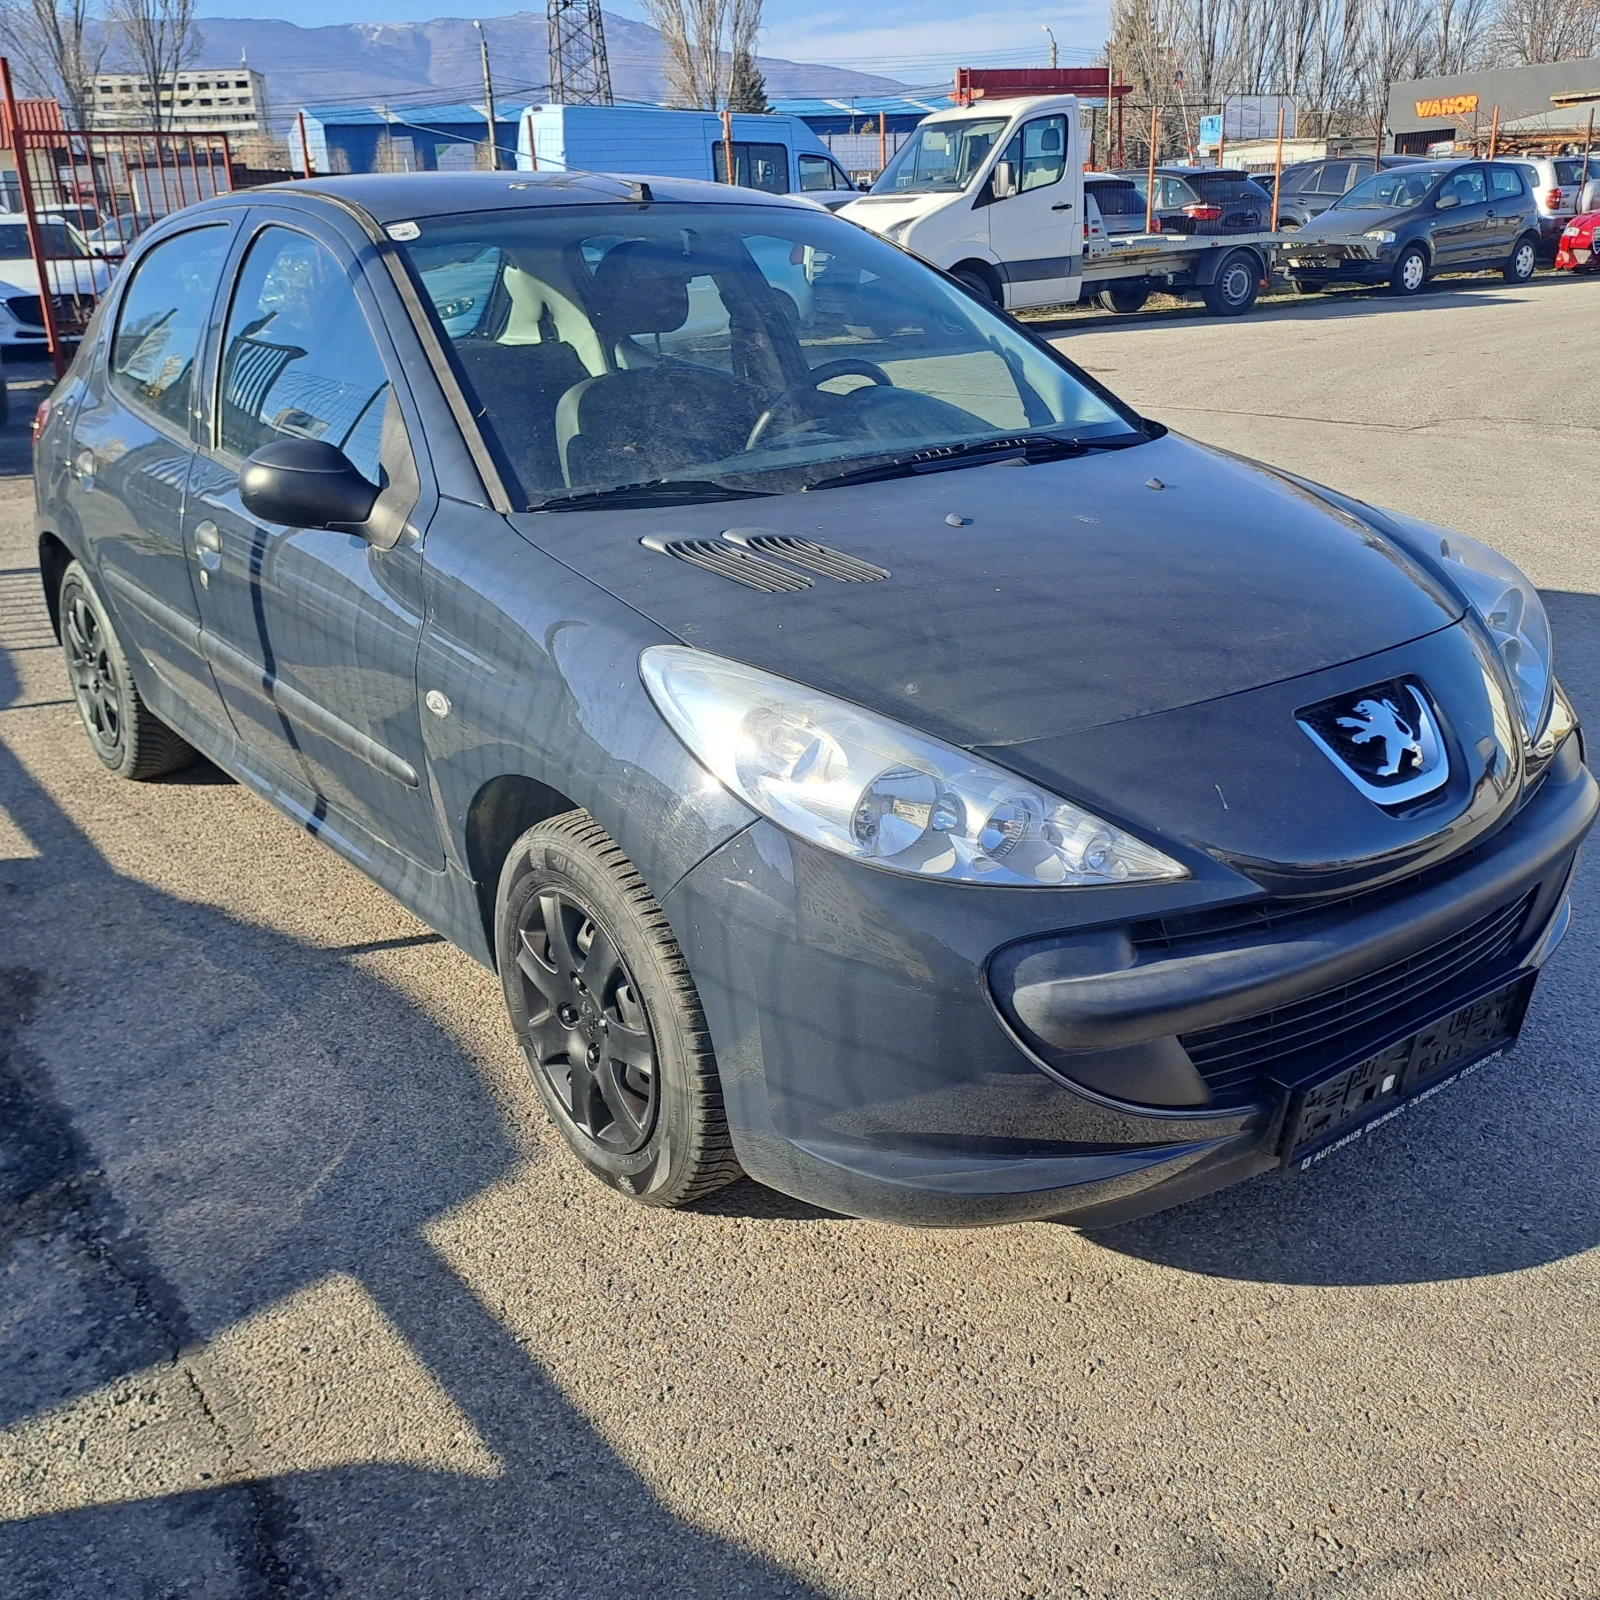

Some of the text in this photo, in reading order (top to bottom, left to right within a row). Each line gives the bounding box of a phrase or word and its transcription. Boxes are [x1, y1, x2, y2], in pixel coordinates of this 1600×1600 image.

[1313, 1128, 1363, 1163] AUTOHAUS
[1365, 1103, 1407, 1133] BRUNNER
[1409, 1073, 1458, 1108] OLBENDORF
